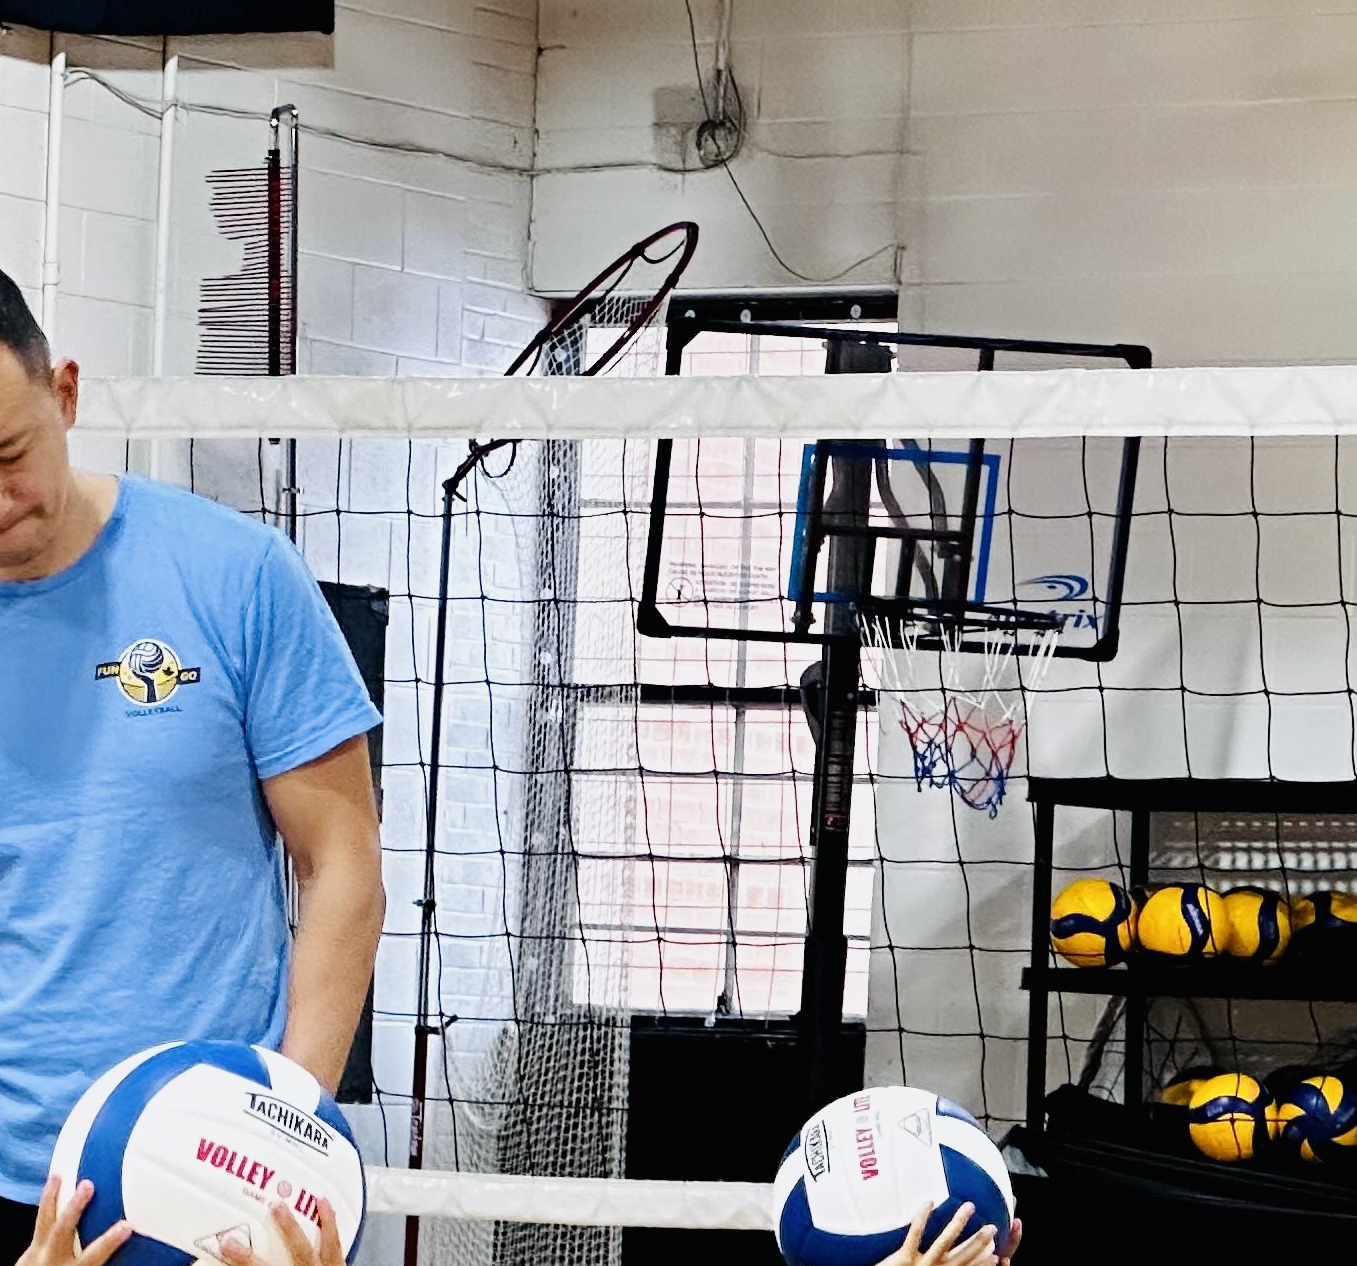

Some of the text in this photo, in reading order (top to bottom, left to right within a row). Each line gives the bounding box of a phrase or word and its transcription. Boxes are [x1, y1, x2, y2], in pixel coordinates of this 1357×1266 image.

[97, 664, 197, 681] FUN GO
[246, 1092, 329, 1150] TACHIKARA
[196, 1137, 276, 1190] VOLLEY
[856, 1128, 879, 1181] VOLLEY
